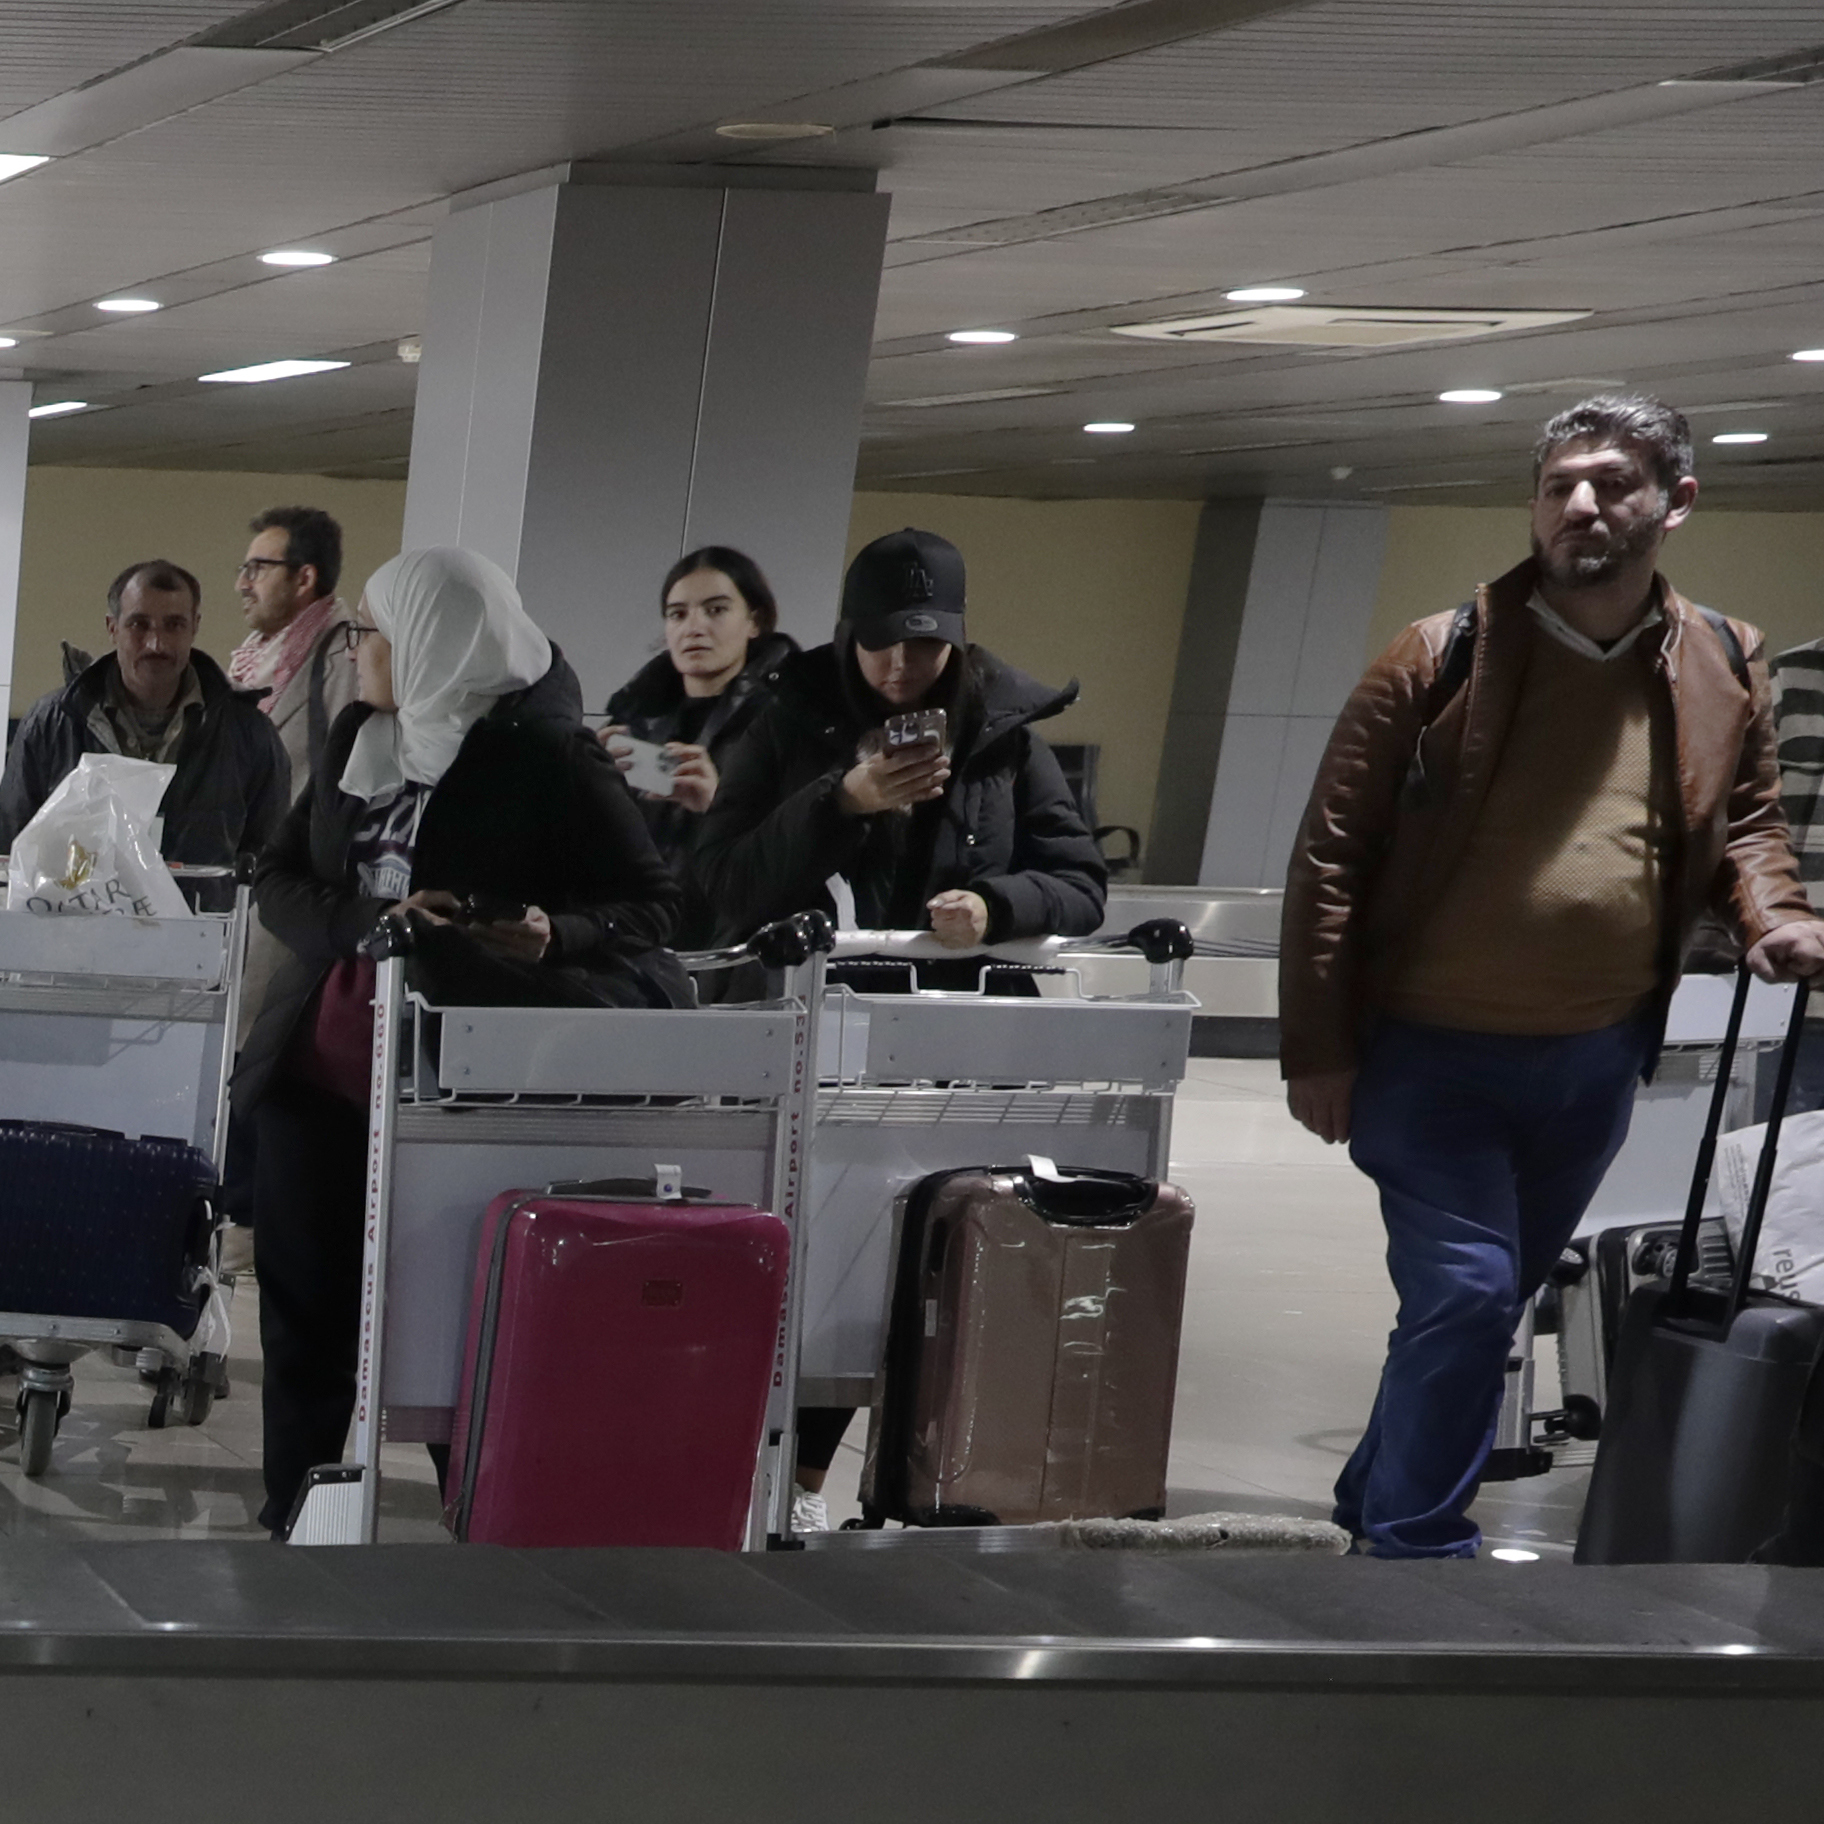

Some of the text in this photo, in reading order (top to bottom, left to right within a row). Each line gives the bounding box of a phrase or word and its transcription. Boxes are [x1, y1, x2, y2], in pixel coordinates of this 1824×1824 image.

[784, 1112, 800, 1219] Airport
[358, 1263, 373, 1422] Damascus
[367, 1130, 380, 1243] Airport
